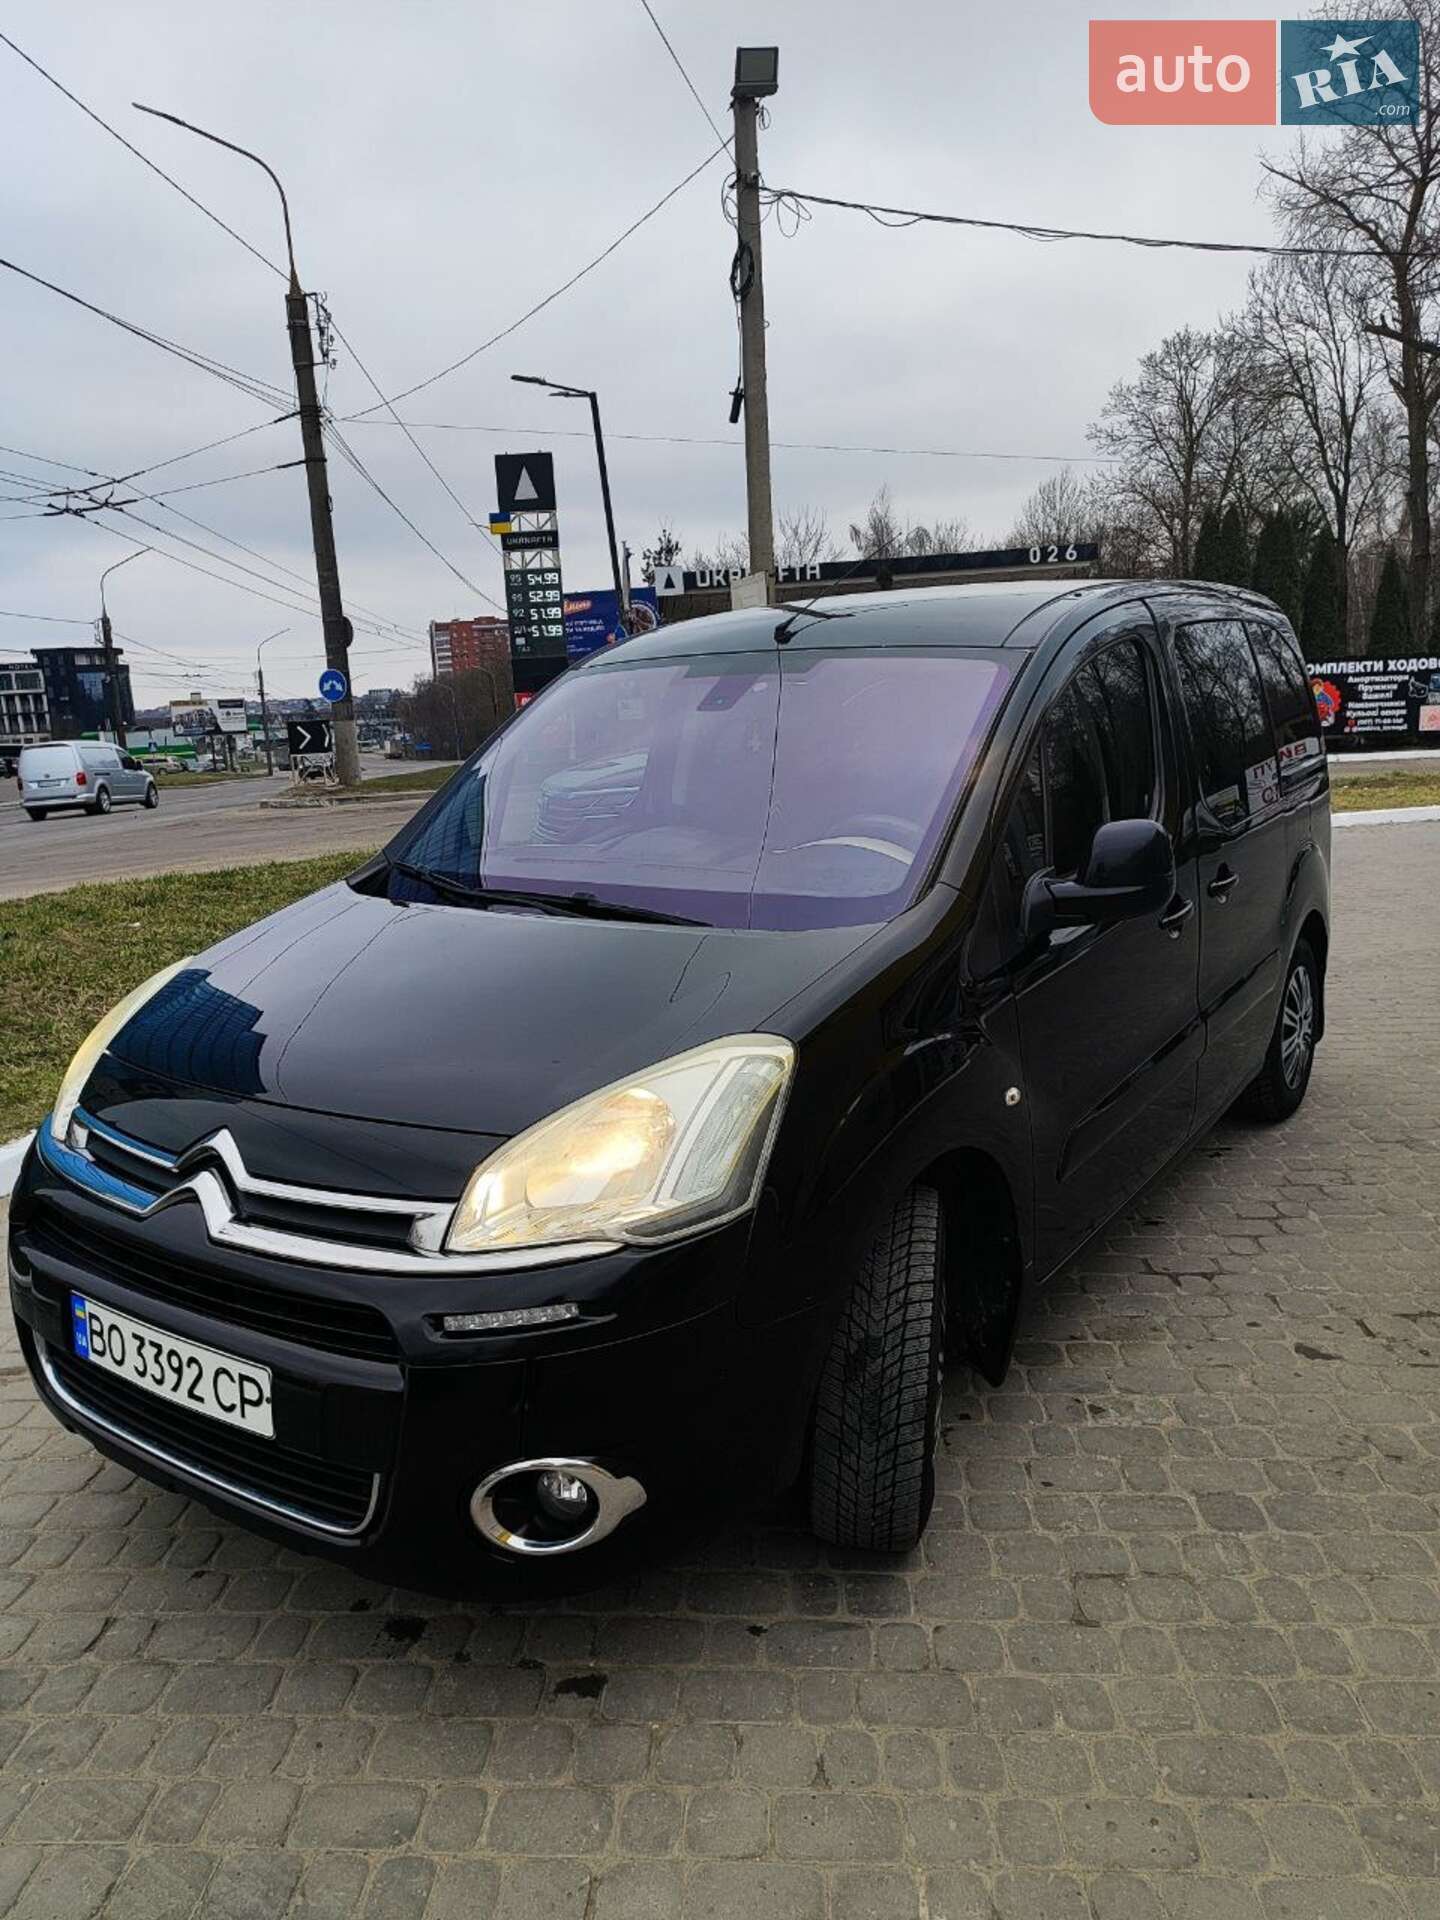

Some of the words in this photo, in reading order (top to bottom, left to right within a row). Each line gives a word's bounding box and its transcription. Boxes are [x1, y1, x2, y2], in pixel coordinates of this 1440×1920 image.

[1029, 544, 1078, 564] 026
[694, 561, 821, 588] UKRFTA
[1306, 660, 1384, 675] ОМПЛЕКТИ
[1387, 657, 1440, 672] ХОДОВ
[88, 1311, 126, 1367] BO
[131, 1332, 205, 1404] 3392
[213, 1367, 264, 1418] CP
